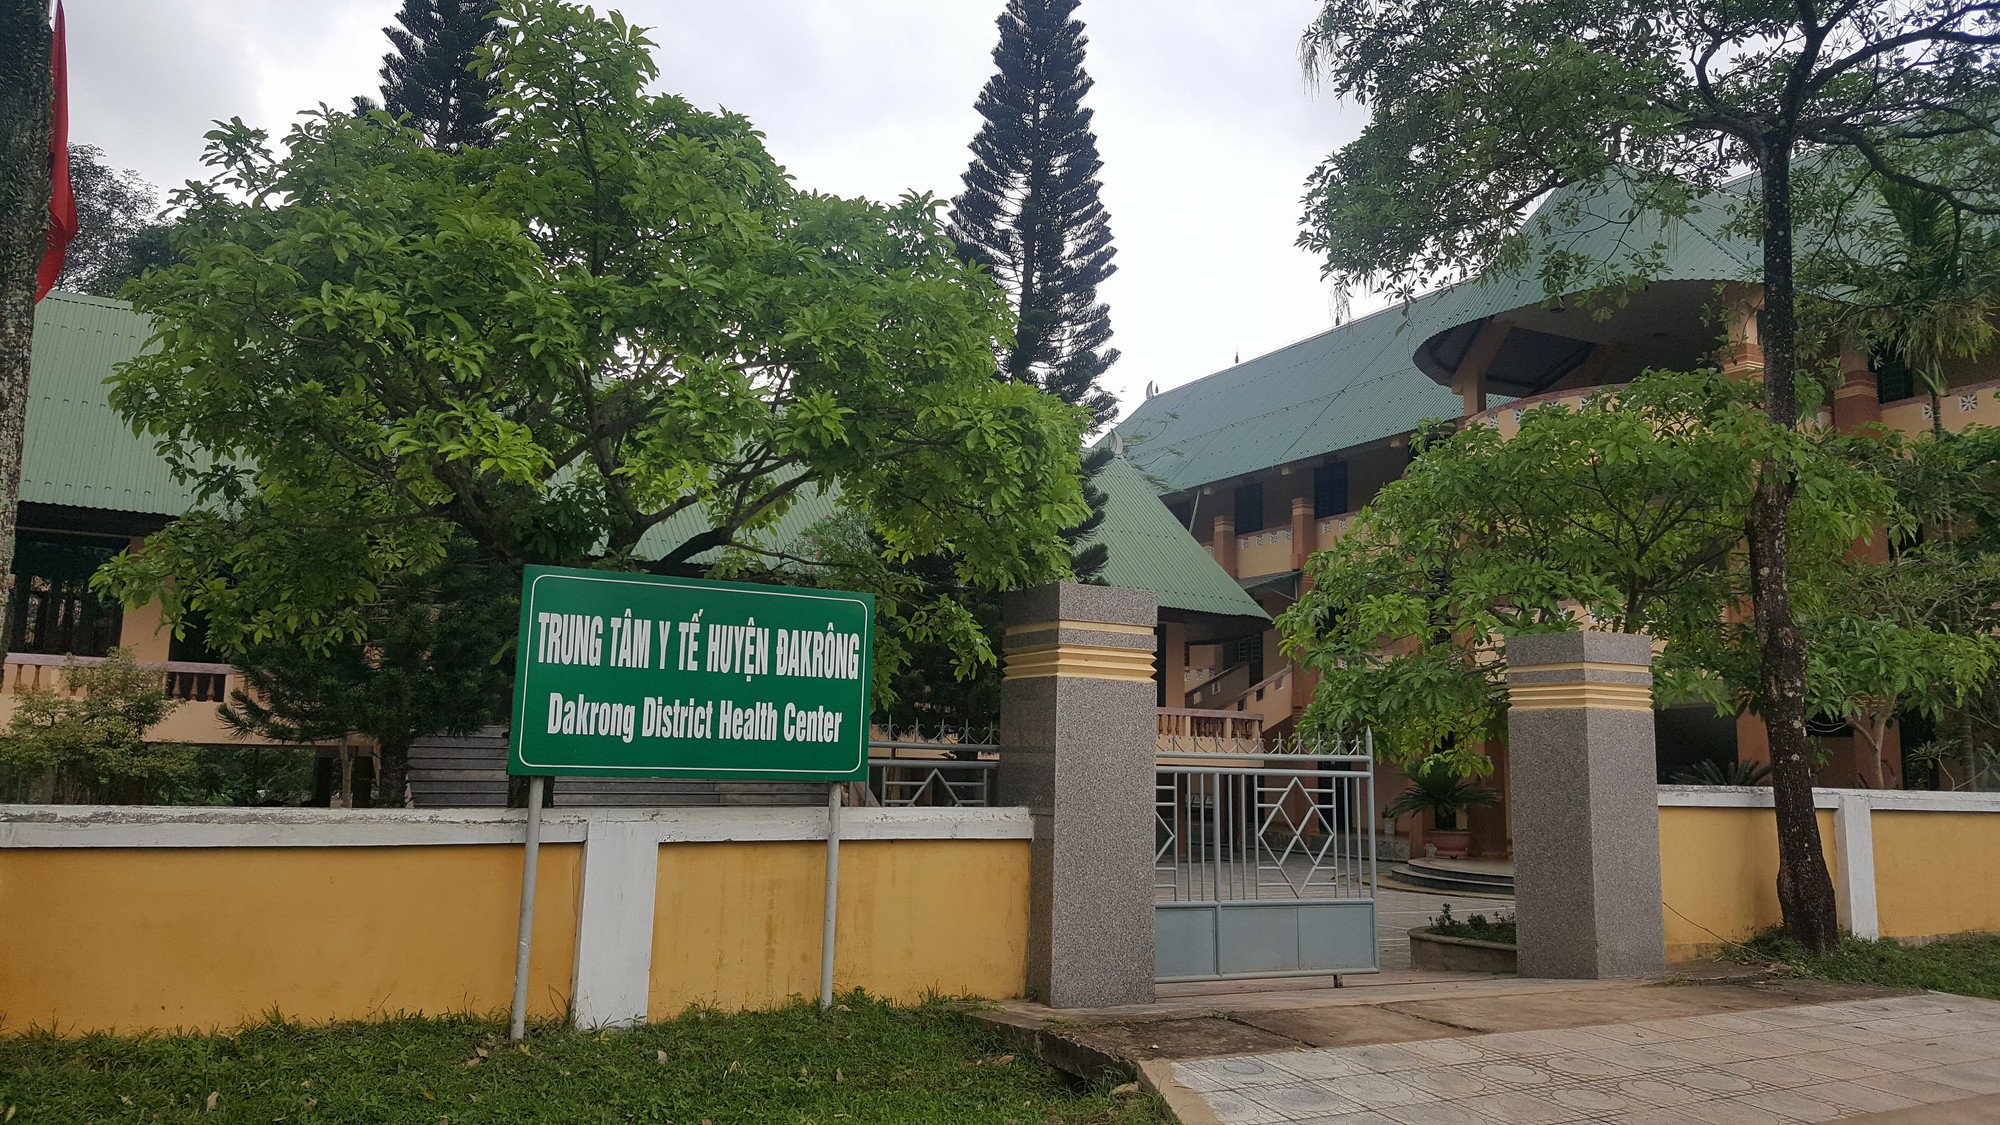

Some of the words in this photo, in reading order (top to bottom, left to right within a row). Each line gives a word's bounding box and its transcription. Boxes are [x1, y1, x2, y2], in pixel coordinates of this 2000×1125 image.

[537, 612, 603, 667] TRUNG
[610, 608, 652, 669] TÂM
[658, 620, 671, 670] Y
[678, 608, 704, 672] TẾ
[706, 616, 769, 682] HUYỆN
[775, 622, 860, 680] ĐAKRÔNG
[547, 692, 636, 743] Dakrong
[641, 696, 713, 739] District
[718, 700, 778, 741] Health
[783, 702, 843, 743] Center
